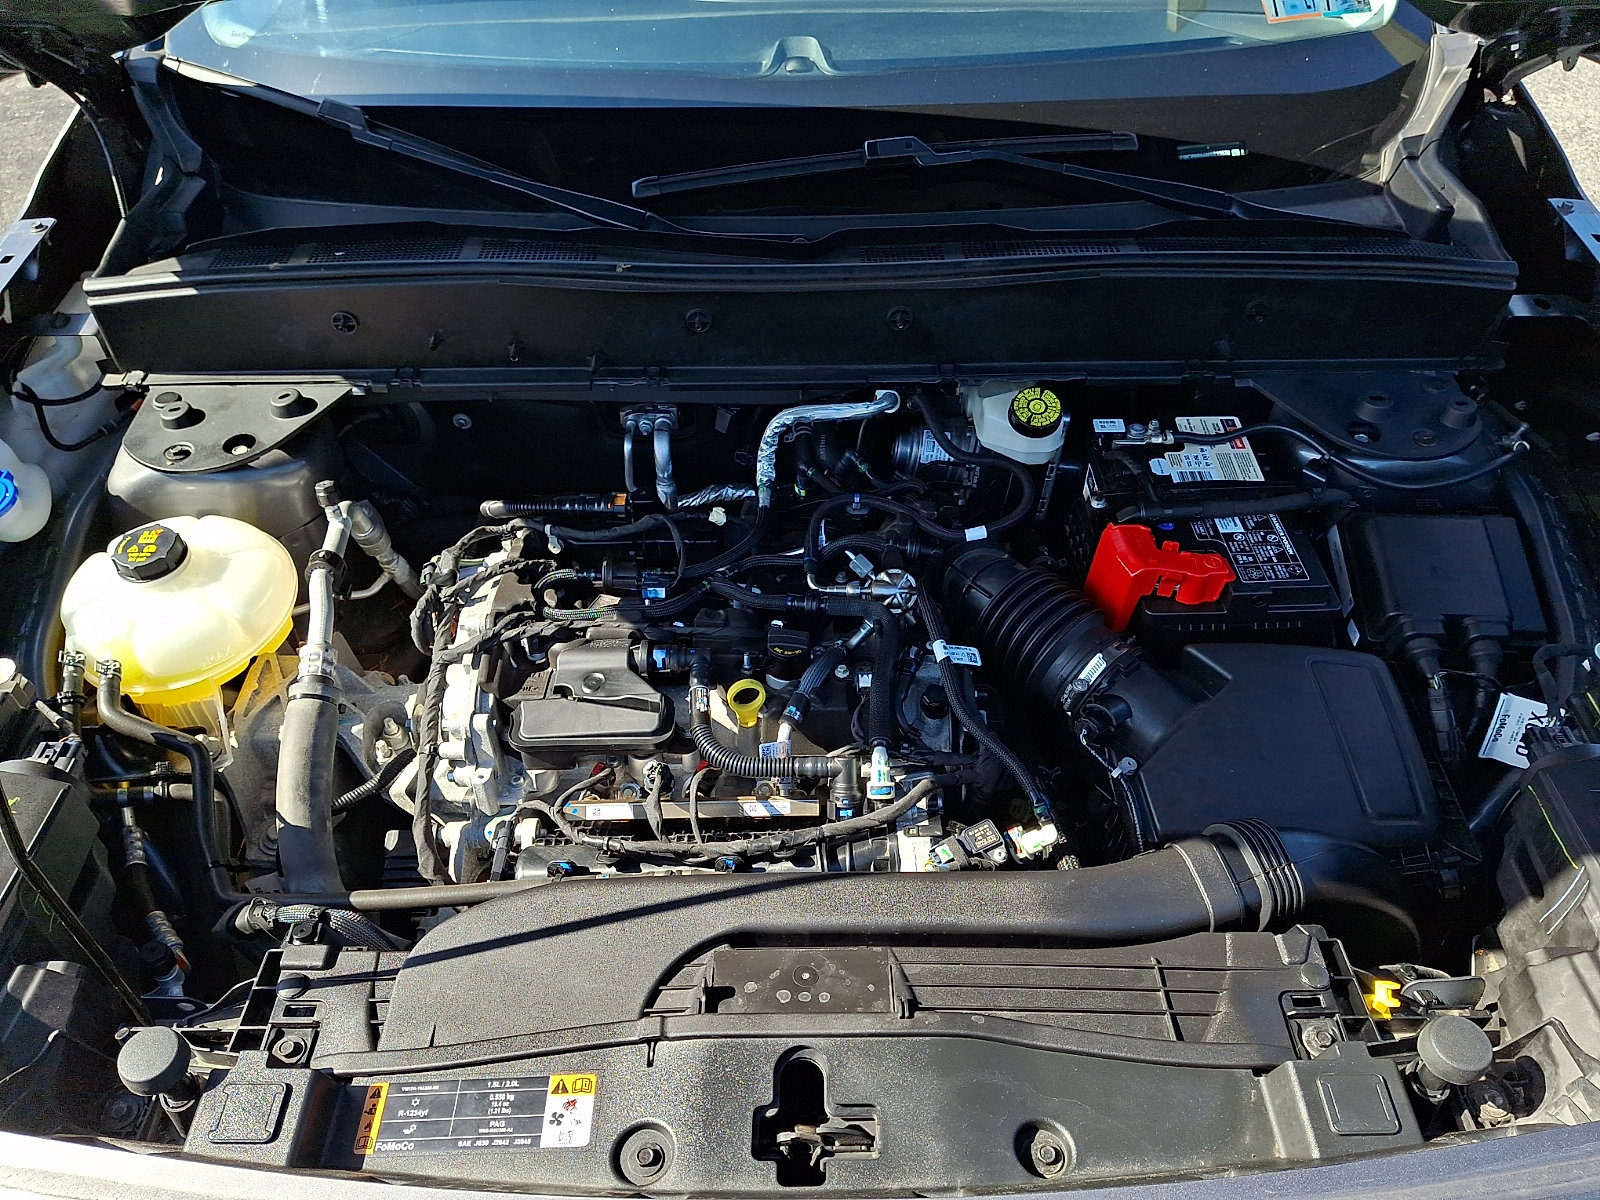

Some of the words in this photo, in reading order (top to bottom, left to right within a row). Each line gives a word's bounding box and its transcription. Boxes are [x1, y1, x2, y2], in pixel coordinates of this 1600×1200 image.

[1491, 714, 1511, 743] FoMoCo
[397, 1108, 429, 1118] R-1234yf
[489, 1120, 506, 1128] PAG
[374, 1141, 415, 1151] FoMoCo
[457, 1140, 472, 1148] SAE
